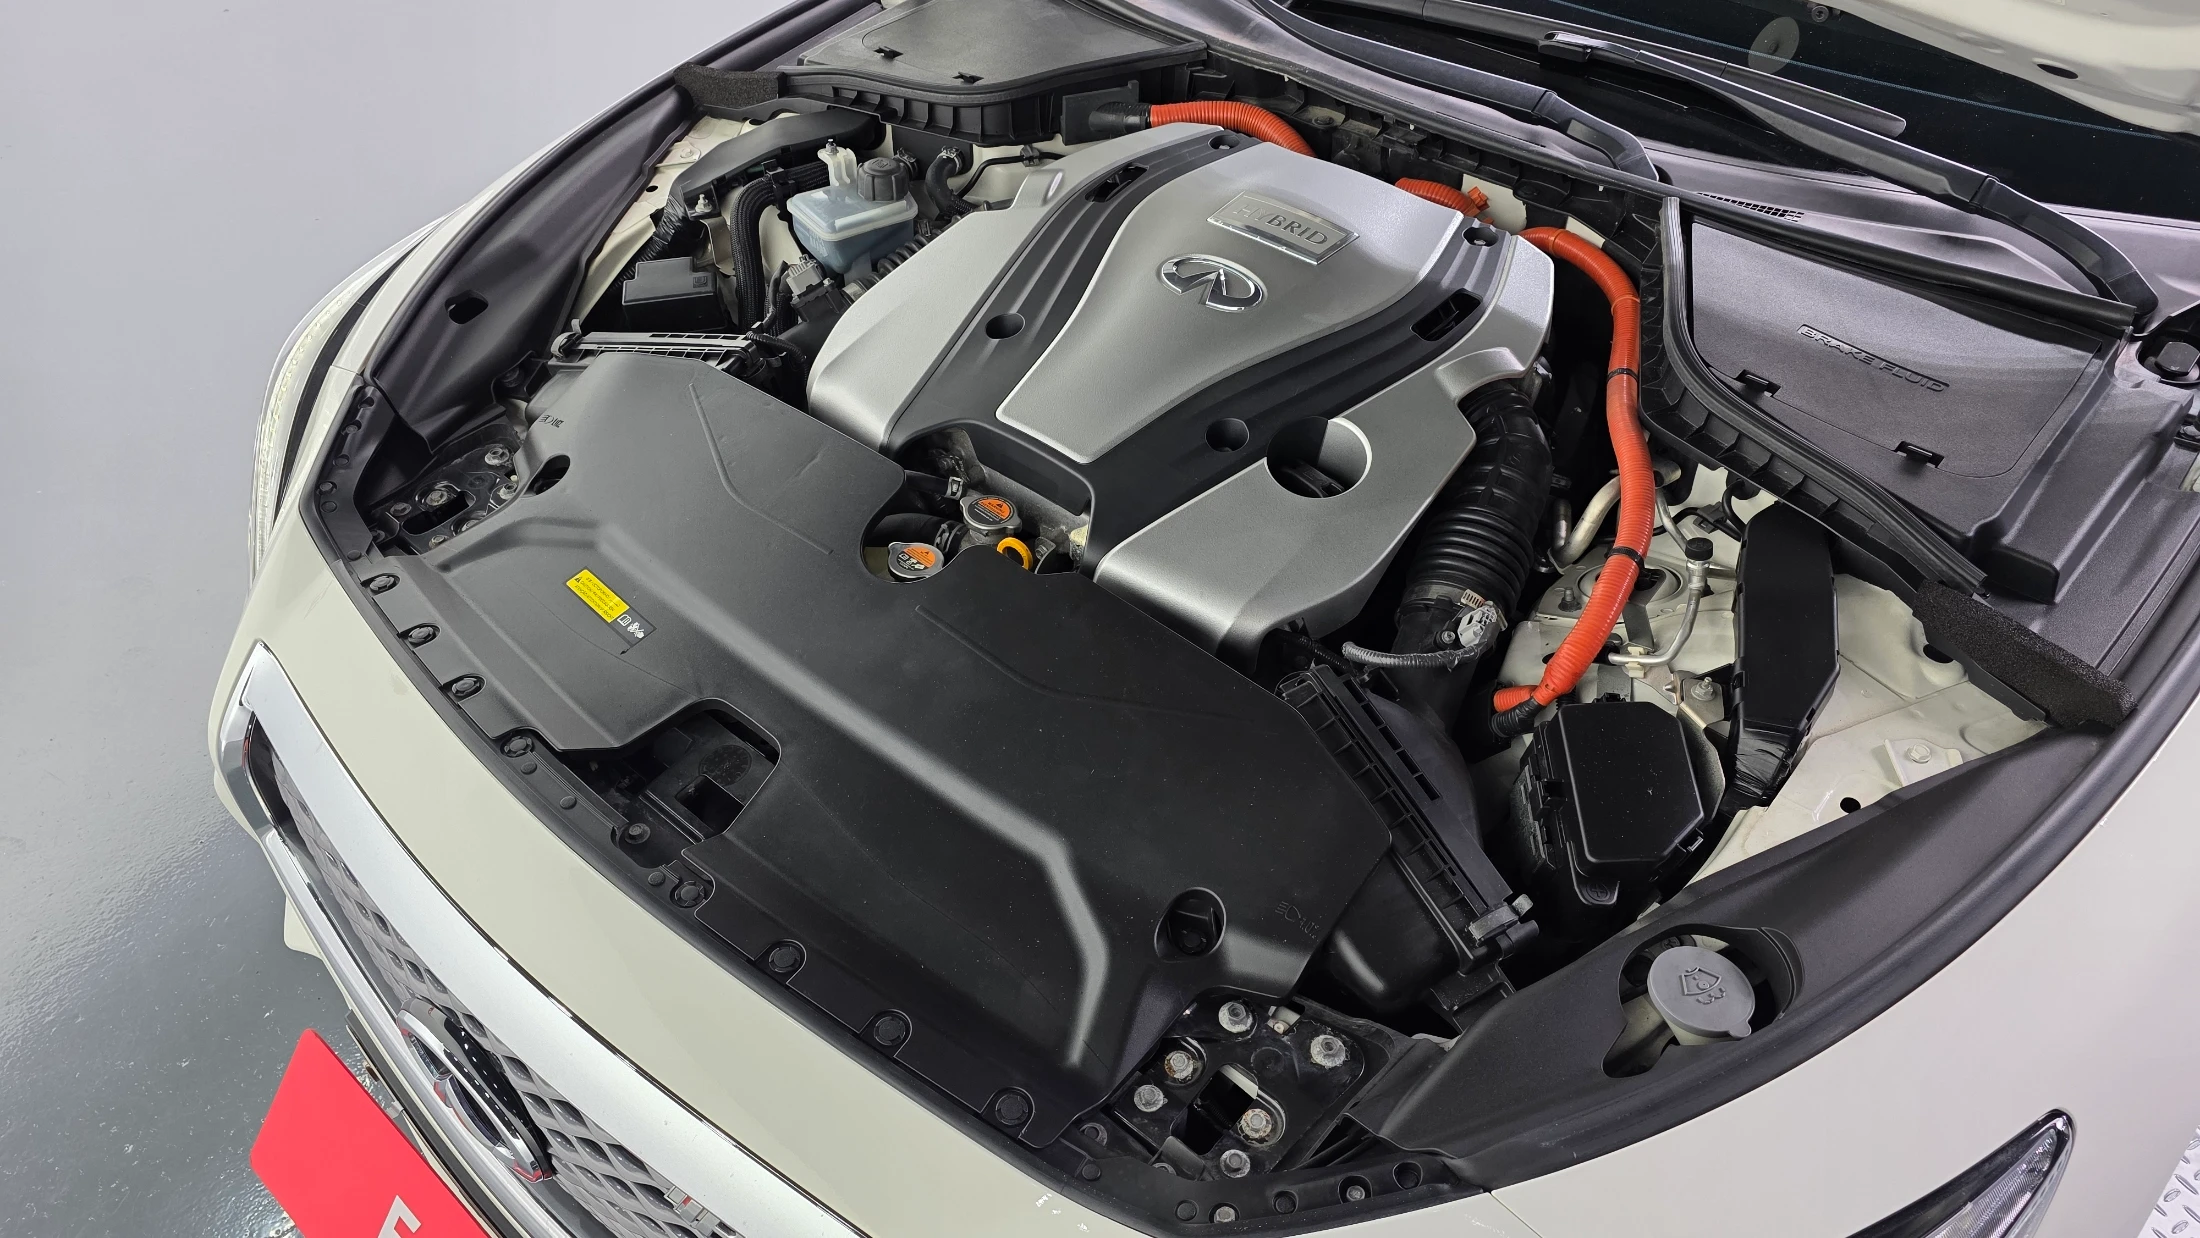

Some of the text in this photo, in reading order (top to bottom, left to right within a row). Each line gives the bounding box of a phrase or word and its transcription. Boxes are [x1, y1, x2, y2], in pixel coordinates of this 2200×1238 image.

[1233, 203, 1328, 245] HYBRID
[1800, 327, 1945, 393] BRAKE FLUID
